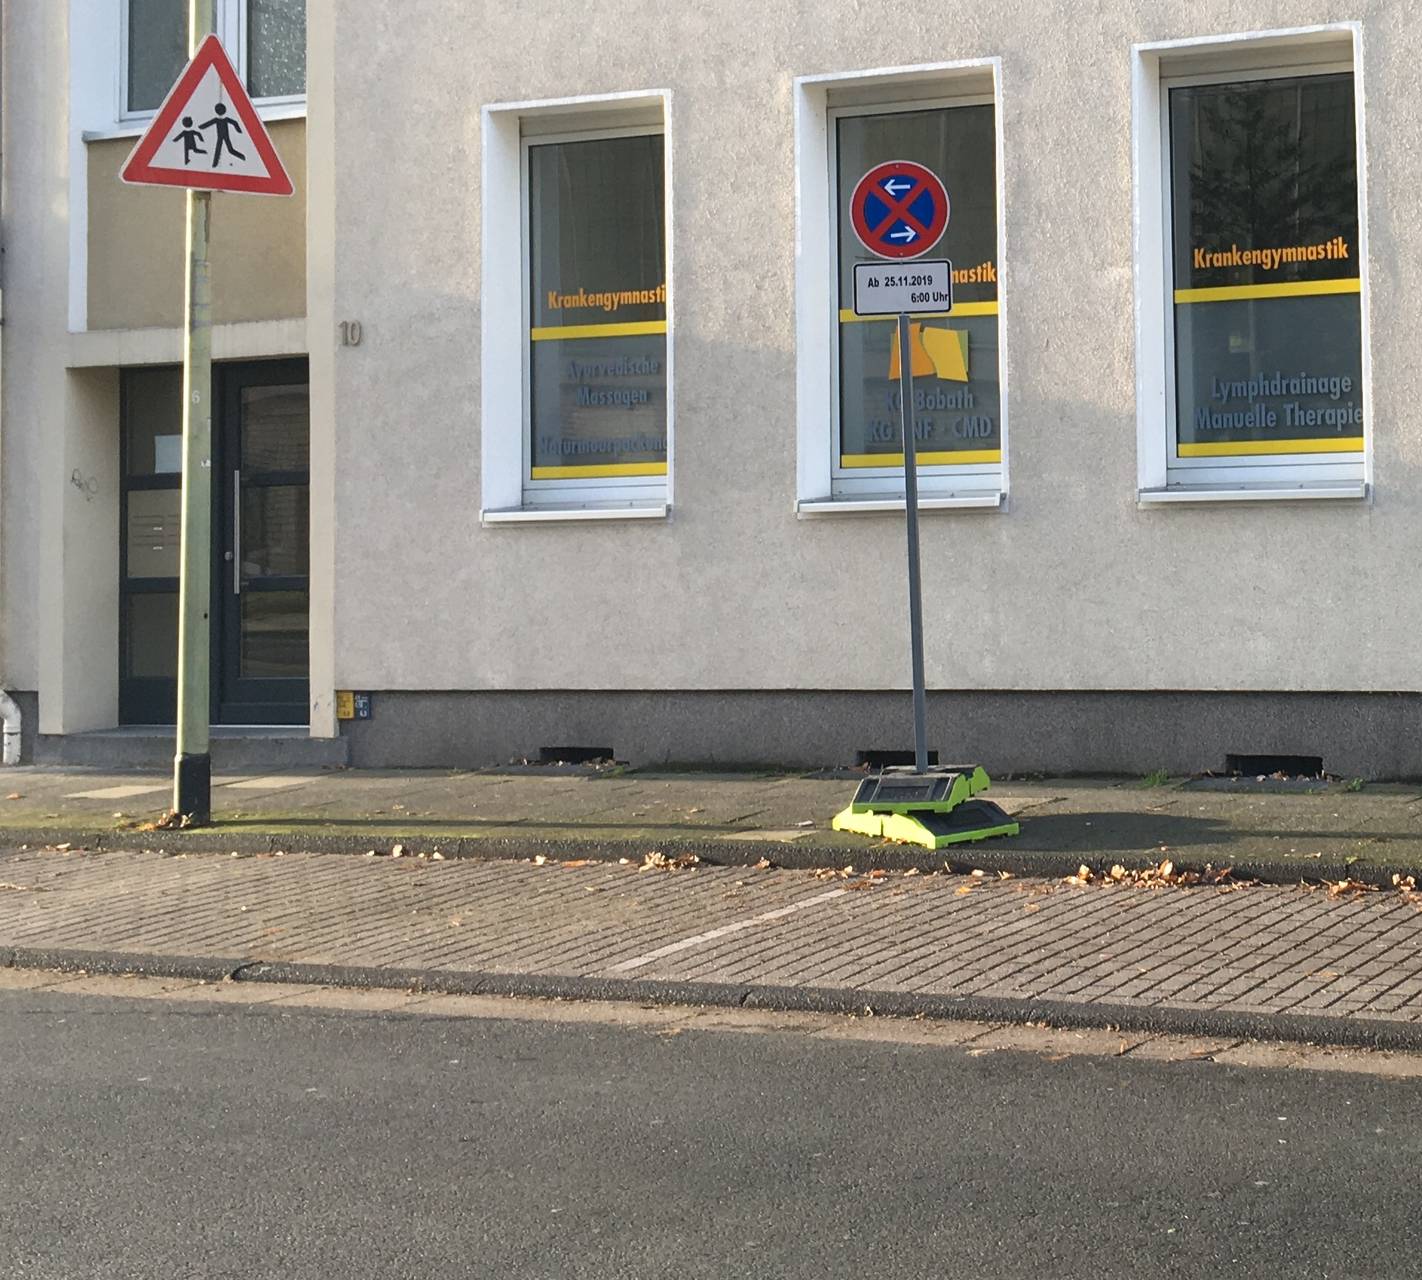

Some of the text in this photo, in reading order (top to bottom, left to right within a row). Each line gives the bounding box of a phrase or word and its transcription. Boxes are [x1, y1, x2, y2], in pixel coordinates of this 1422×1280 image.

[1194, 236, 1349, 270] Krankengymnastik
[867, 275, 933, 288] Ab 25.11.2019
[548, 283, 666, 311] Krankengymnasti
[911, 290, 949, 303] 6:00 Uhr
[337, 320, 362, 347] 10
[191, 390, 200, 404] 6
[576, 387, 648, 408] Massagen
[915, 387, 974, 411] Bobath
[1211, 371, 1352, 403] Lymphdrainage
[952, 415, 993, 440] CMD
[1194, 401, 1363, 432] Manuelle Therapie
